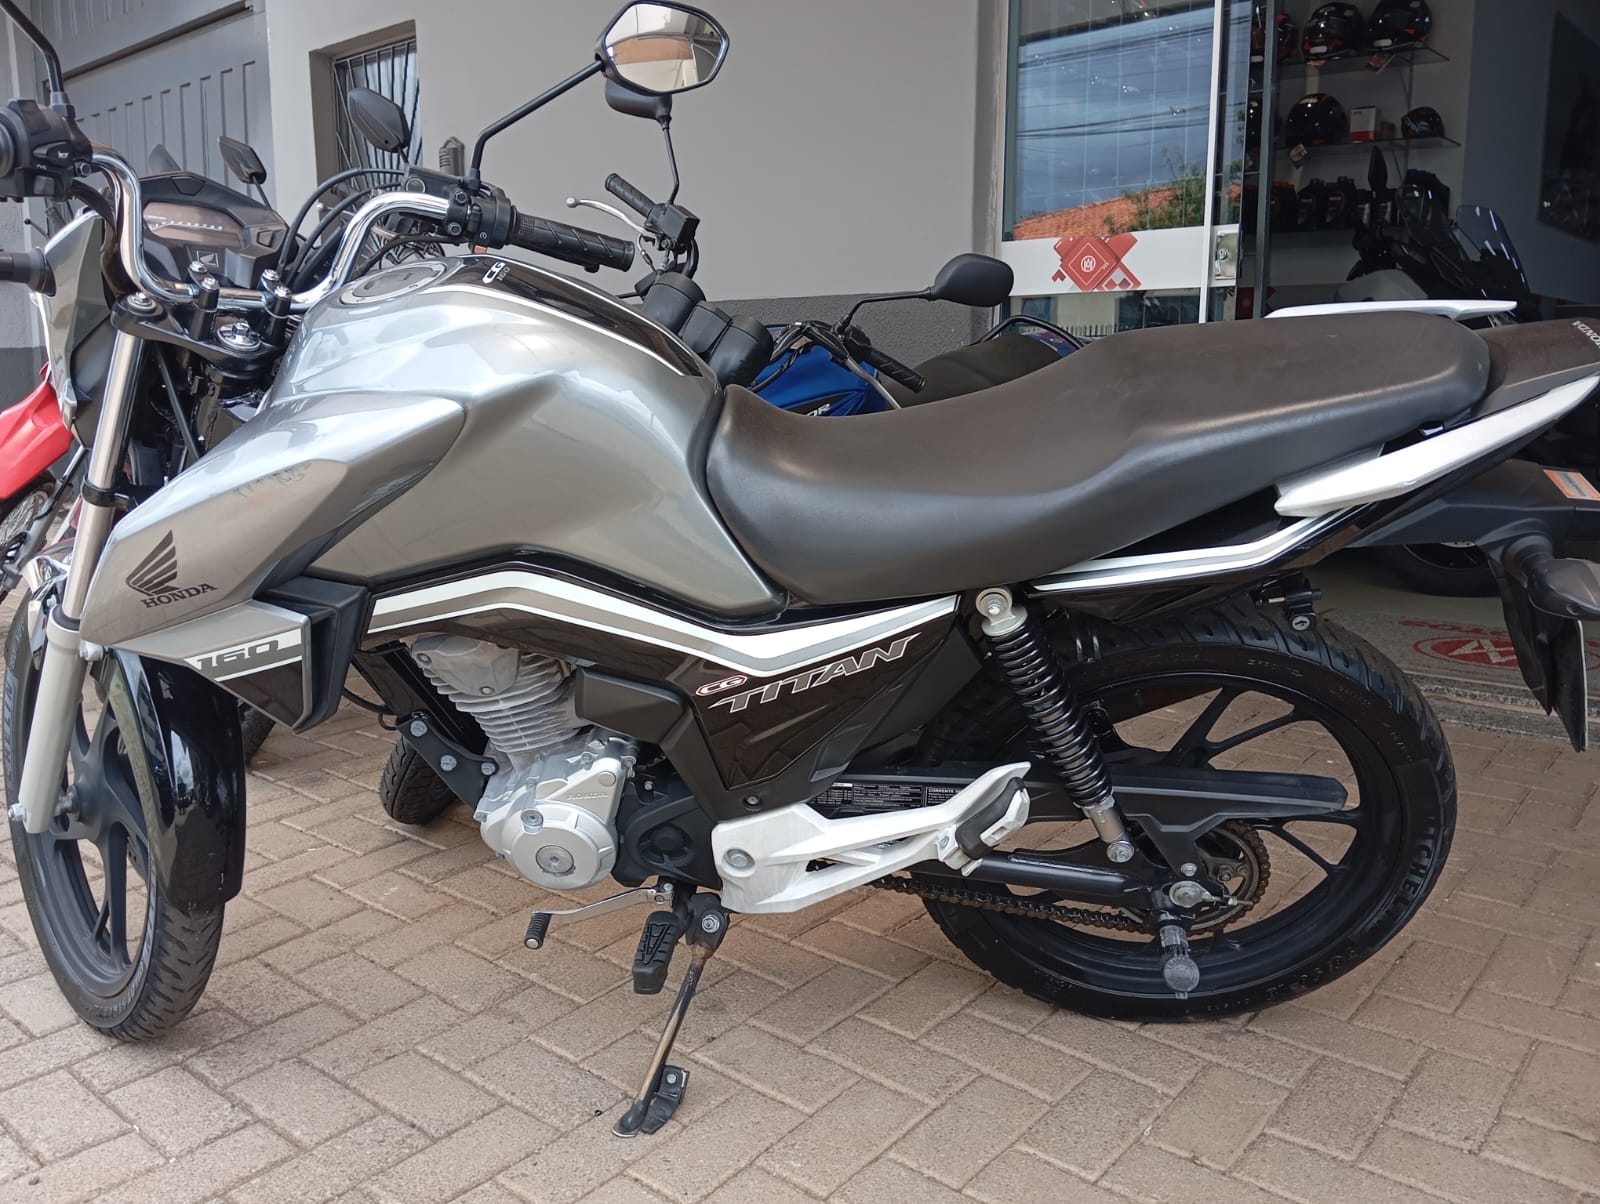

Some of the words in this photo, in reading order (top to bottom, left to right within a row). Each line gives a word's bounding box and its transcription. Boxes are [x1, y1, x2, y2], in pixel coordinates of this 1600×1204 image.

[482, 261, 506, 284] CG
[496, 266, 510, 281] 160
[140, 583, 219, 608] HONDA
[196, 639, 280, 671] 160
[707, 632, 922, 714] TITAN
[696, 674, 748, 697] CG
